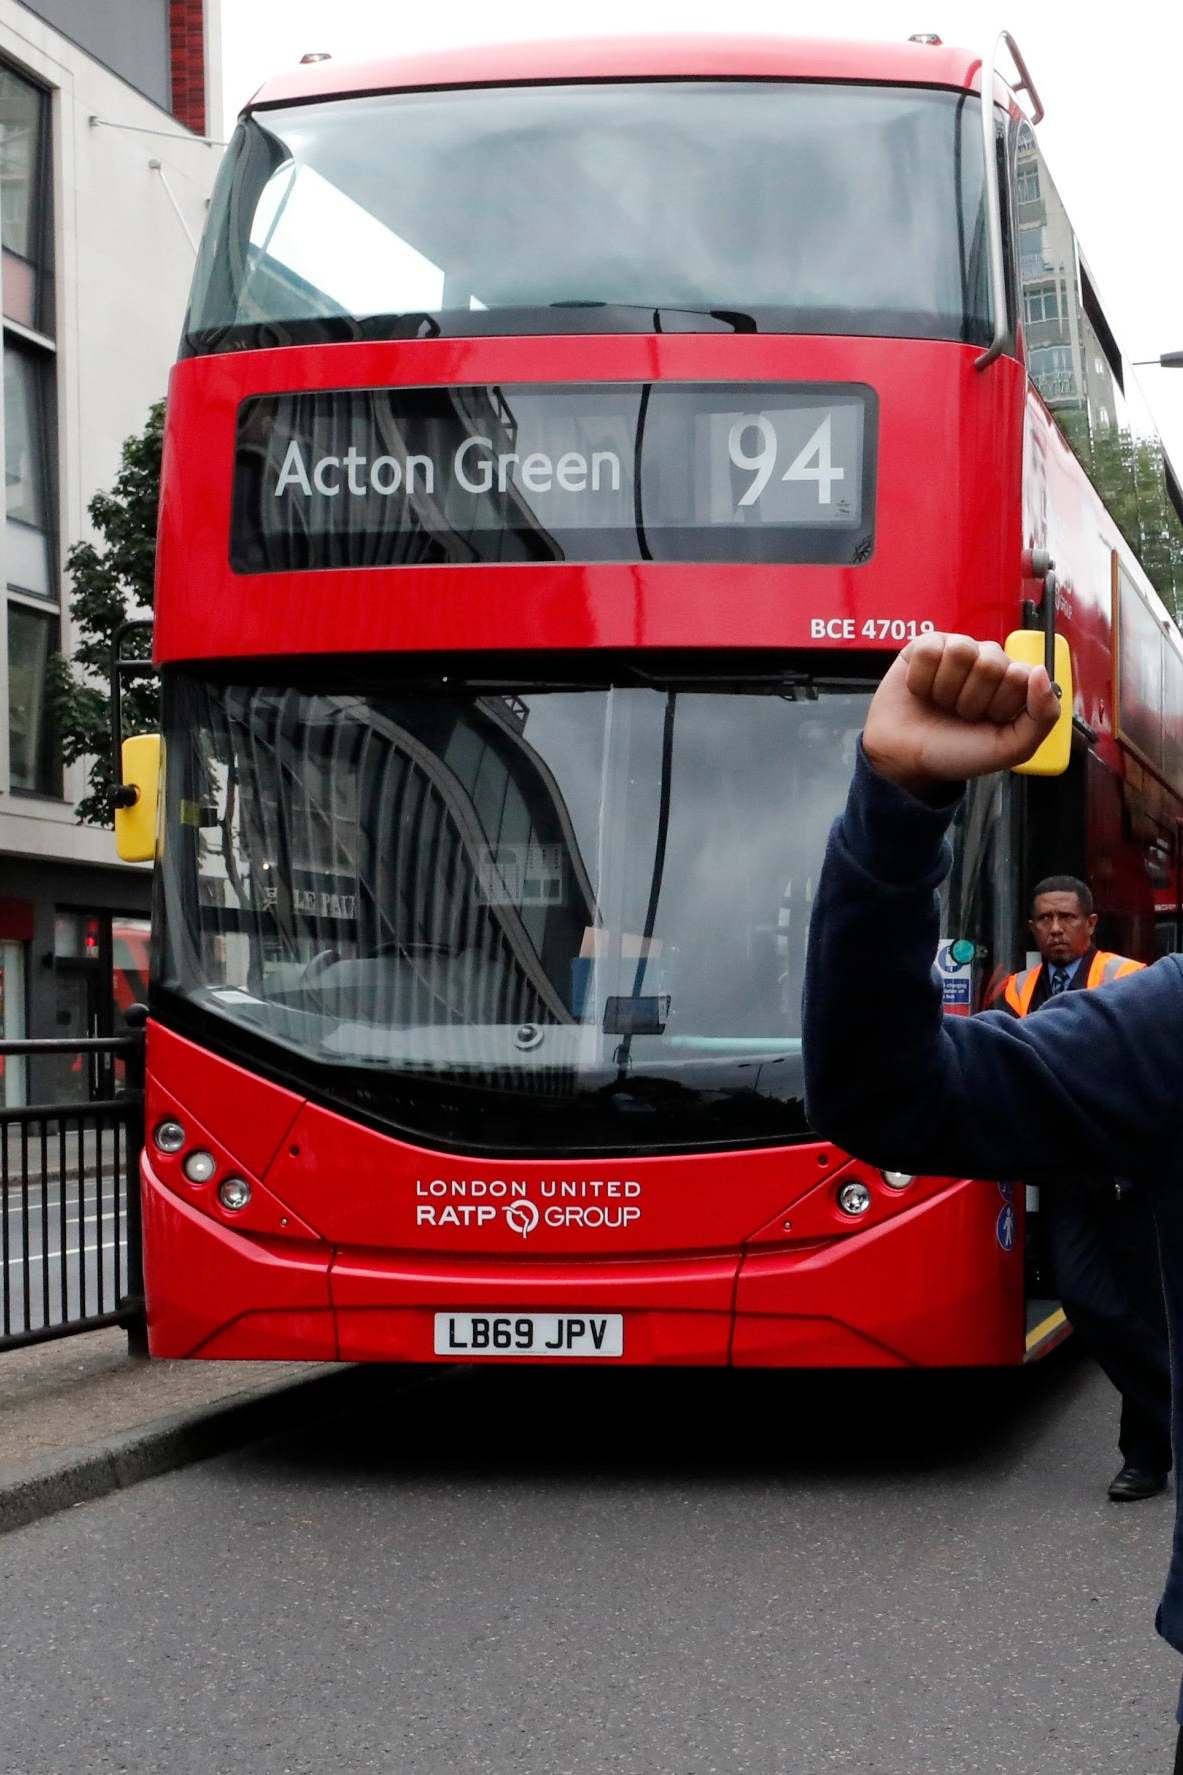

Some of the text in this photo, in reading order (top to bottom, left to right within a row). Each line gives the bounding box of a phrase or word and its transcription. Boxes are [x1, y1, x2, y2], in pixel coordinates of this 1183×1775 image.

[274, 413, 845, 506] Acton Green 94
[811, 618, 856, 639] BCE
[416, 1180, 641, 1197] LONDON UNITED
[416, 1205, 641, 1227] RATP GROUP
[449, 1318, 607, 1349] LB69 JPV
